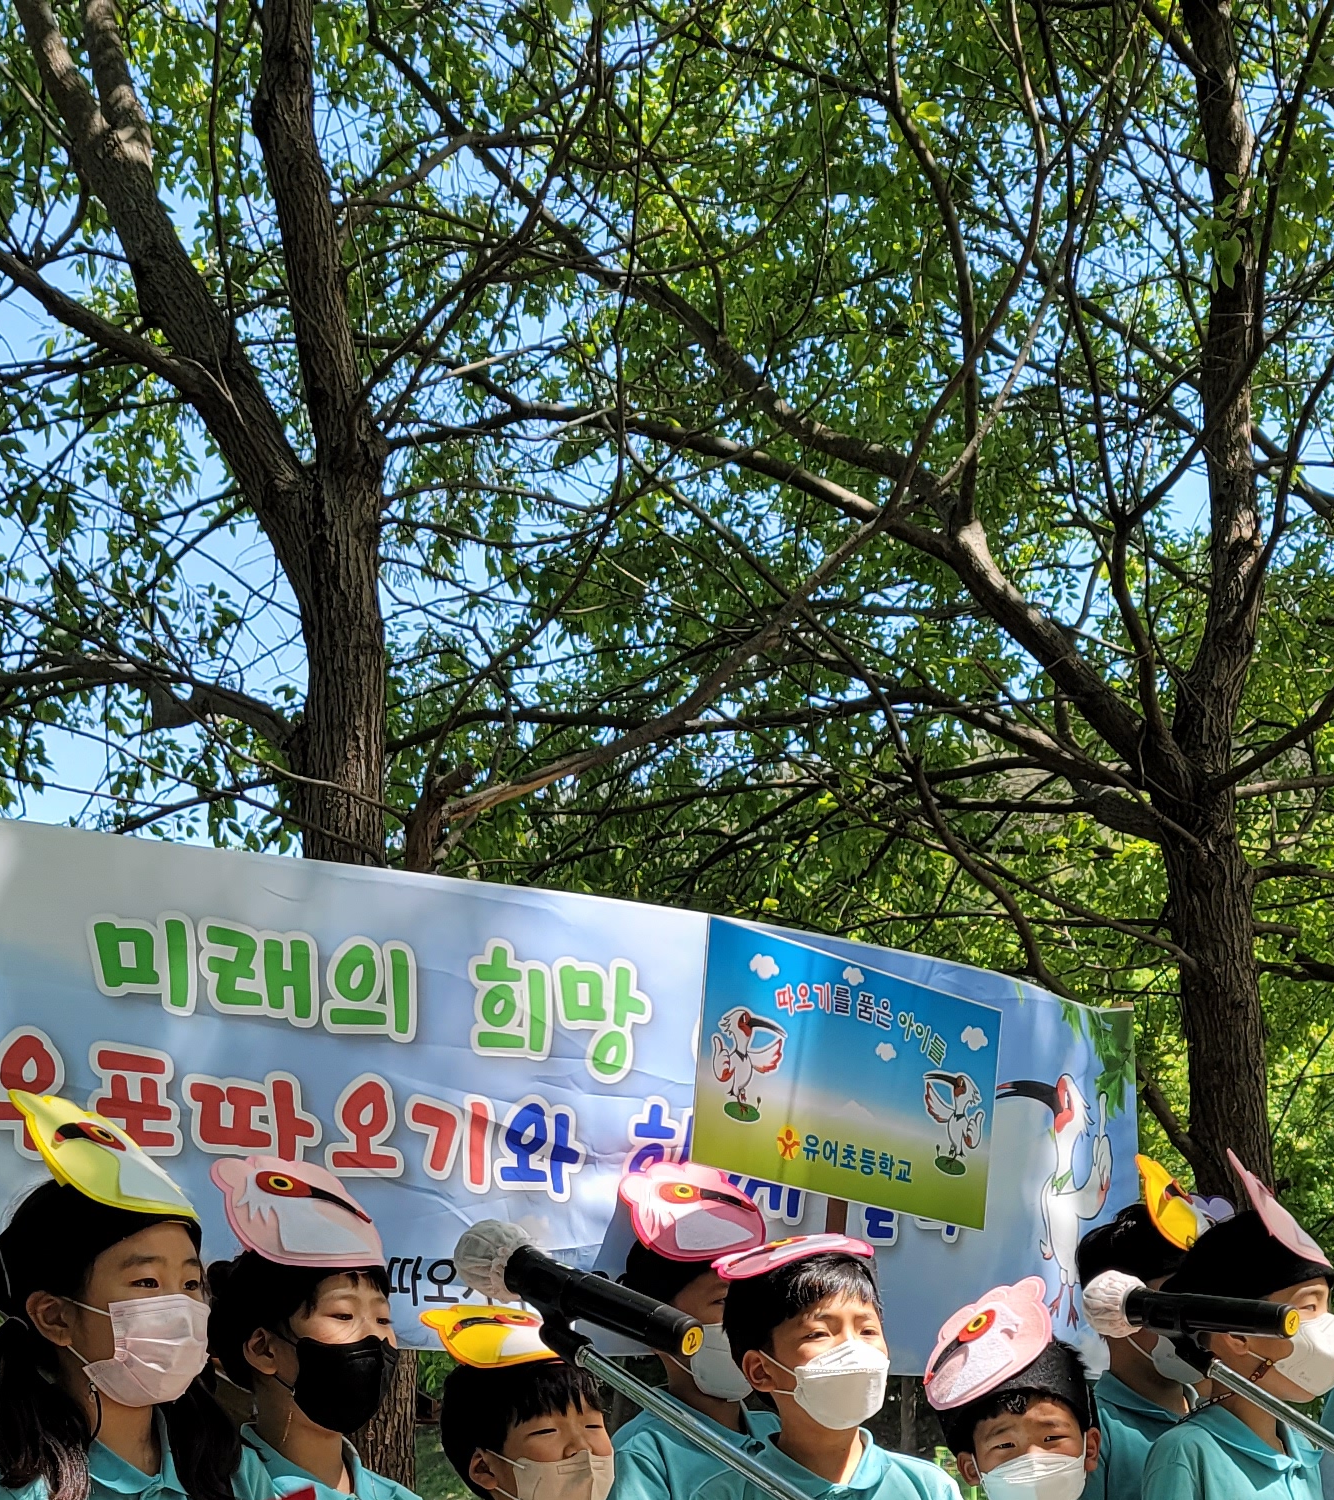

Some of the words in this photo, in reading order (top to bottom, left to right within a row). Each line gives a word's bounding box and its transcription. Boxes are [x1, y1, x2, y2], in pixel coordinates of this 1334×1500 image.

[95, 914, 417, 1040] 미래의
[473, 942, 649, 1080] 희망
[774, 982, 852, 1017] 따오기를
[857, 992, 893, 1030] 품은
[897, 1010, 947, 1068] 아이들
[802, 1133, 913, 1184] 유어초등학교
